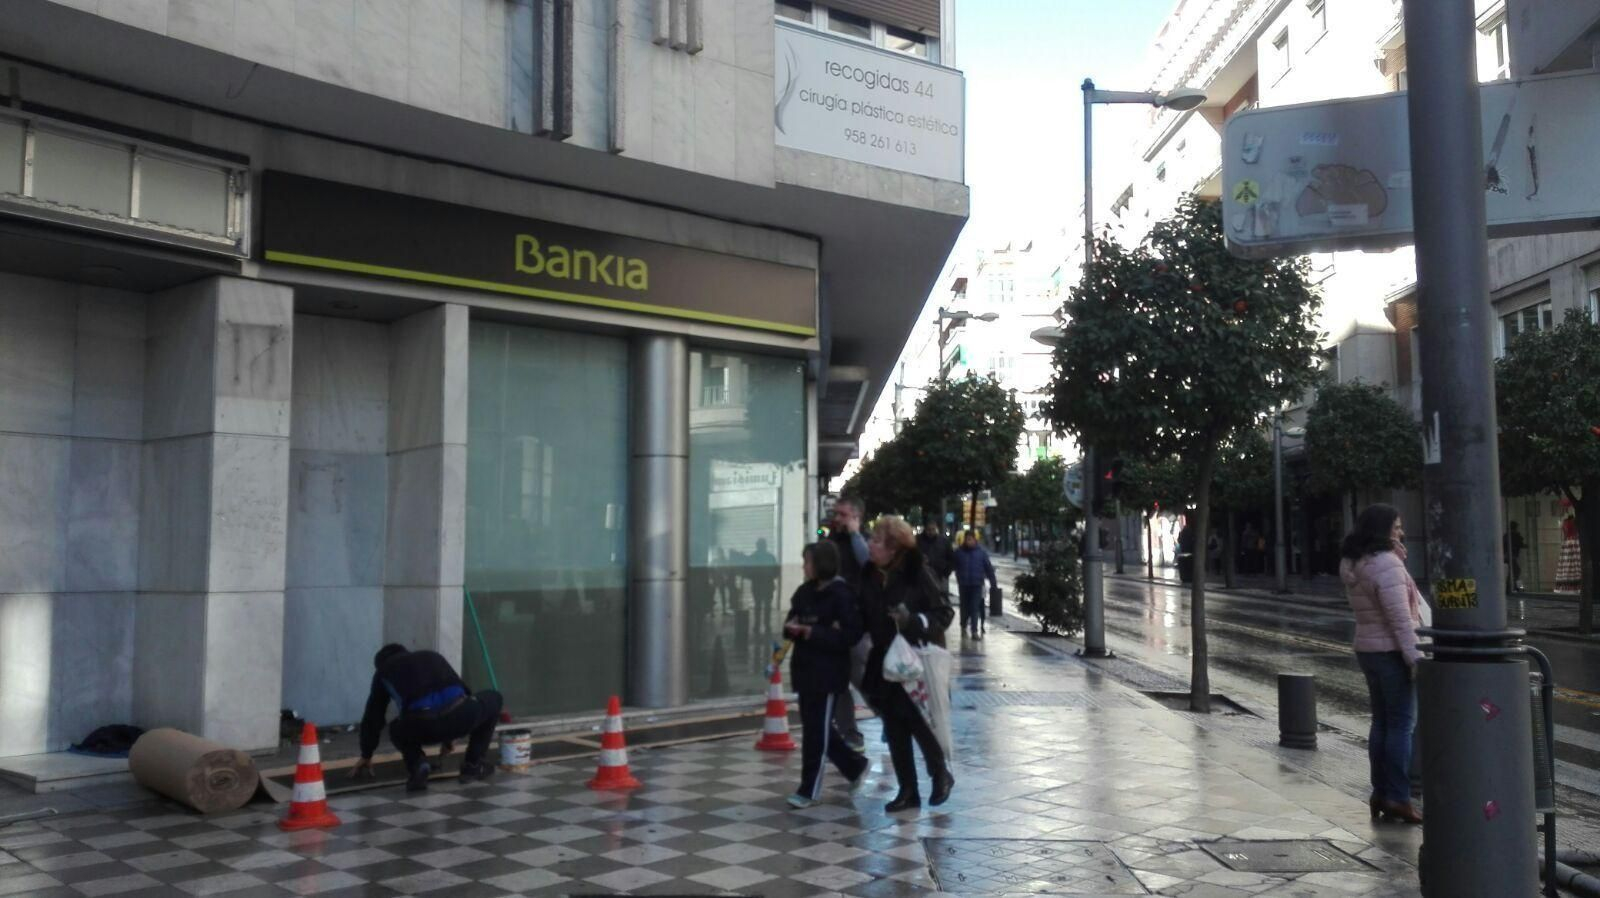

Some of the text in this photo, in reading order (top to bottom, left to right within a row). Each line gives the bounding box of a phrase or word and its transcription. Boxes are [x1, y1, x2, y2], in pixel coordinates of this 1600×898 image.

[825, 60, 934, 99] recogidas 44
[799, 88, 958, 136] cirugía plástica estética
[844, 128, 917, 155] 958 261 613
[515, 234, 648, 290] Bankia
